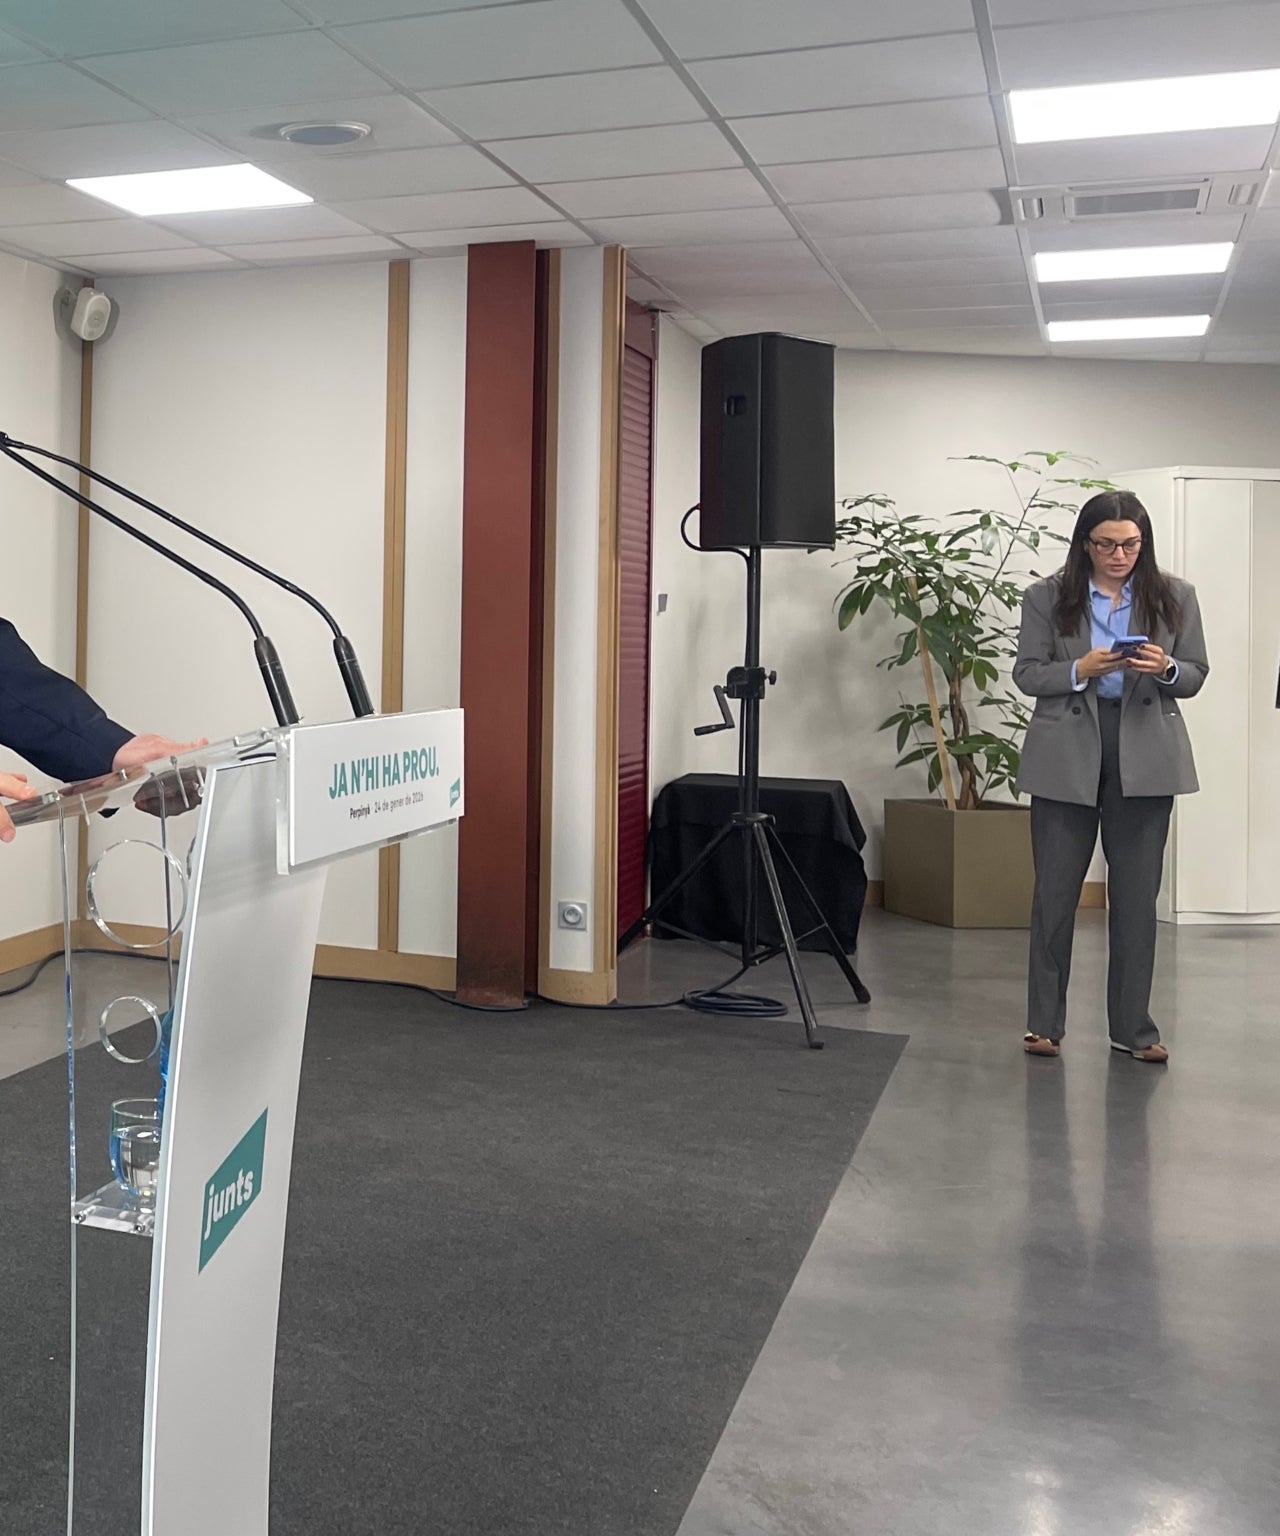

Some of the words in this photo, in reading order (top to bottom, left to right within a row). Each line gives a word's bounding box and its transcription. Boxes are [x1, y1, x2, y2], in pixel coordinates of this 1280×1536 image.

[329, 762, 349, 800] JA
[382, 753, 401, 788] HA
[402, 746, 440, 784] PROU.
[382, 798, 389, 811] de
[405, 793, 412, 806] de
[203, 1167, 254, 1241] junts
